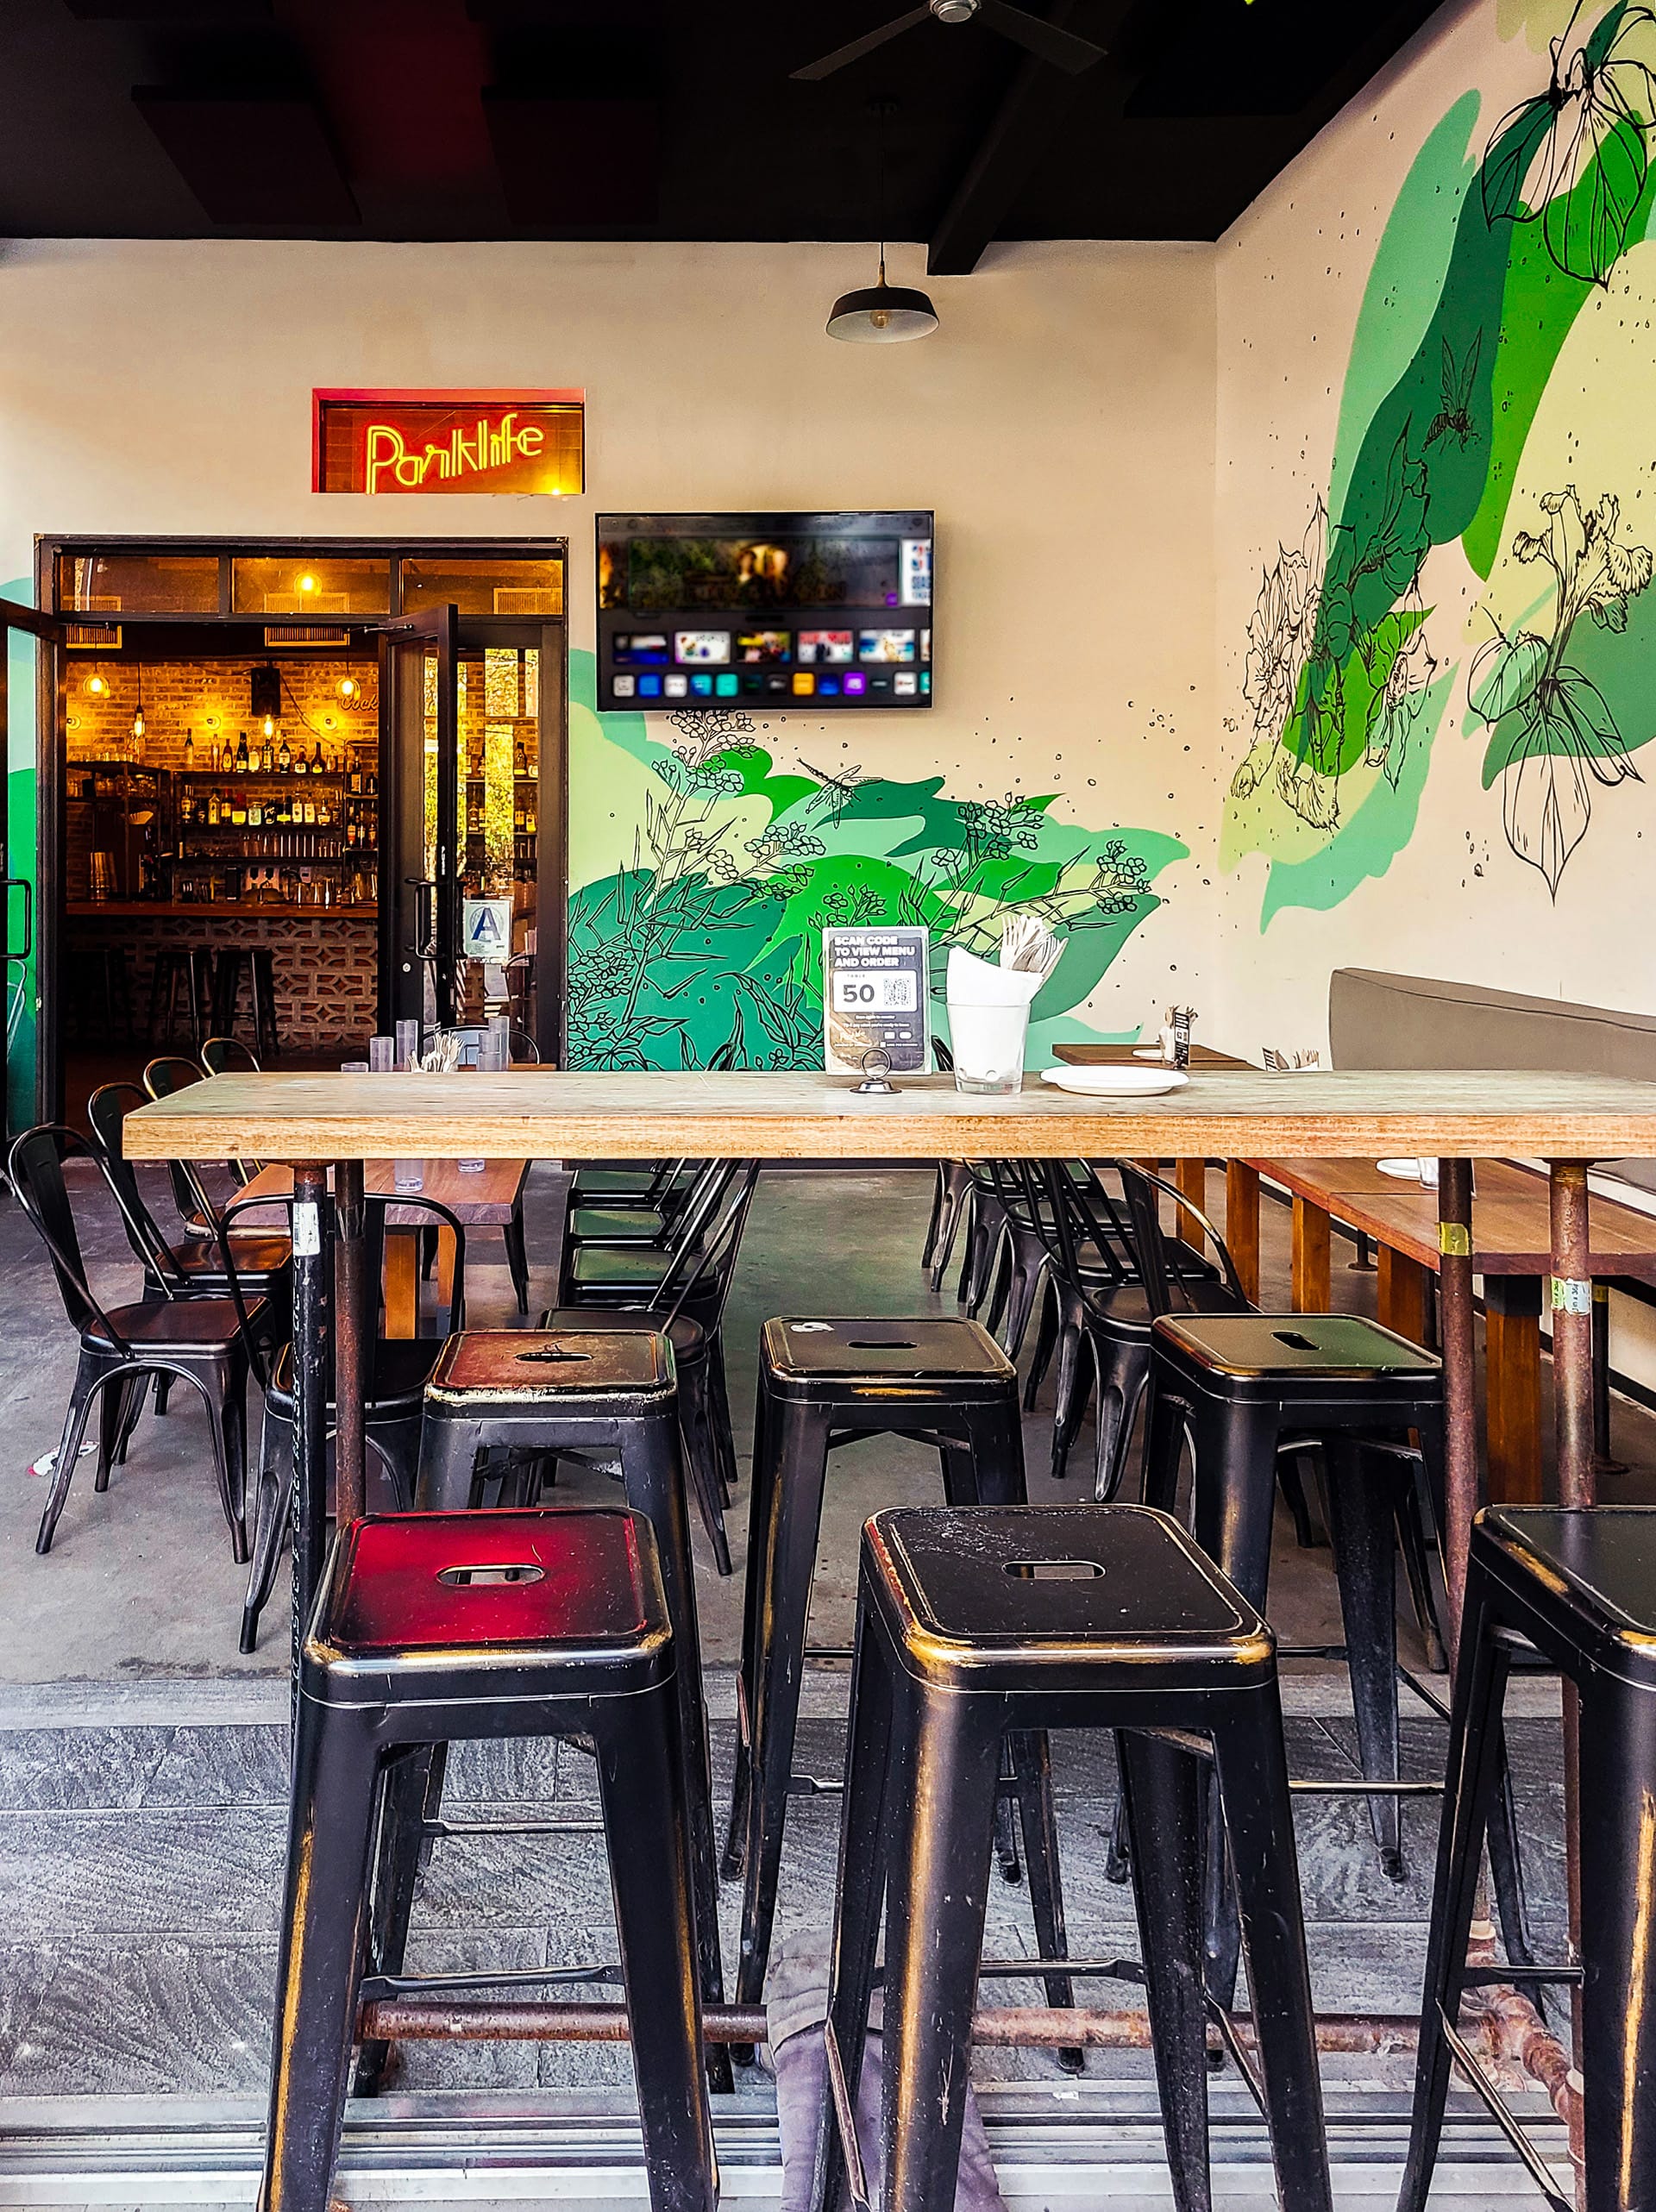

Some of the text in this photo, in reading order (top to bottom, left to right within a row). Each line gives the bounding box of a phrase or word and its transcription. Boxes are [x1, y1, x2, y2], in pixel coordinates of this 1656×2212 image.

[366, 413, 544, 494] Parklife
[471, 907, 501, 940] A
[834, 935, 898, 946] SCAN CODE
[834, 946, 915, 956] TO VIEW MENU
[834, 957, 900, 967] AND ORDER
[843, 984, 875, 1003] 50
